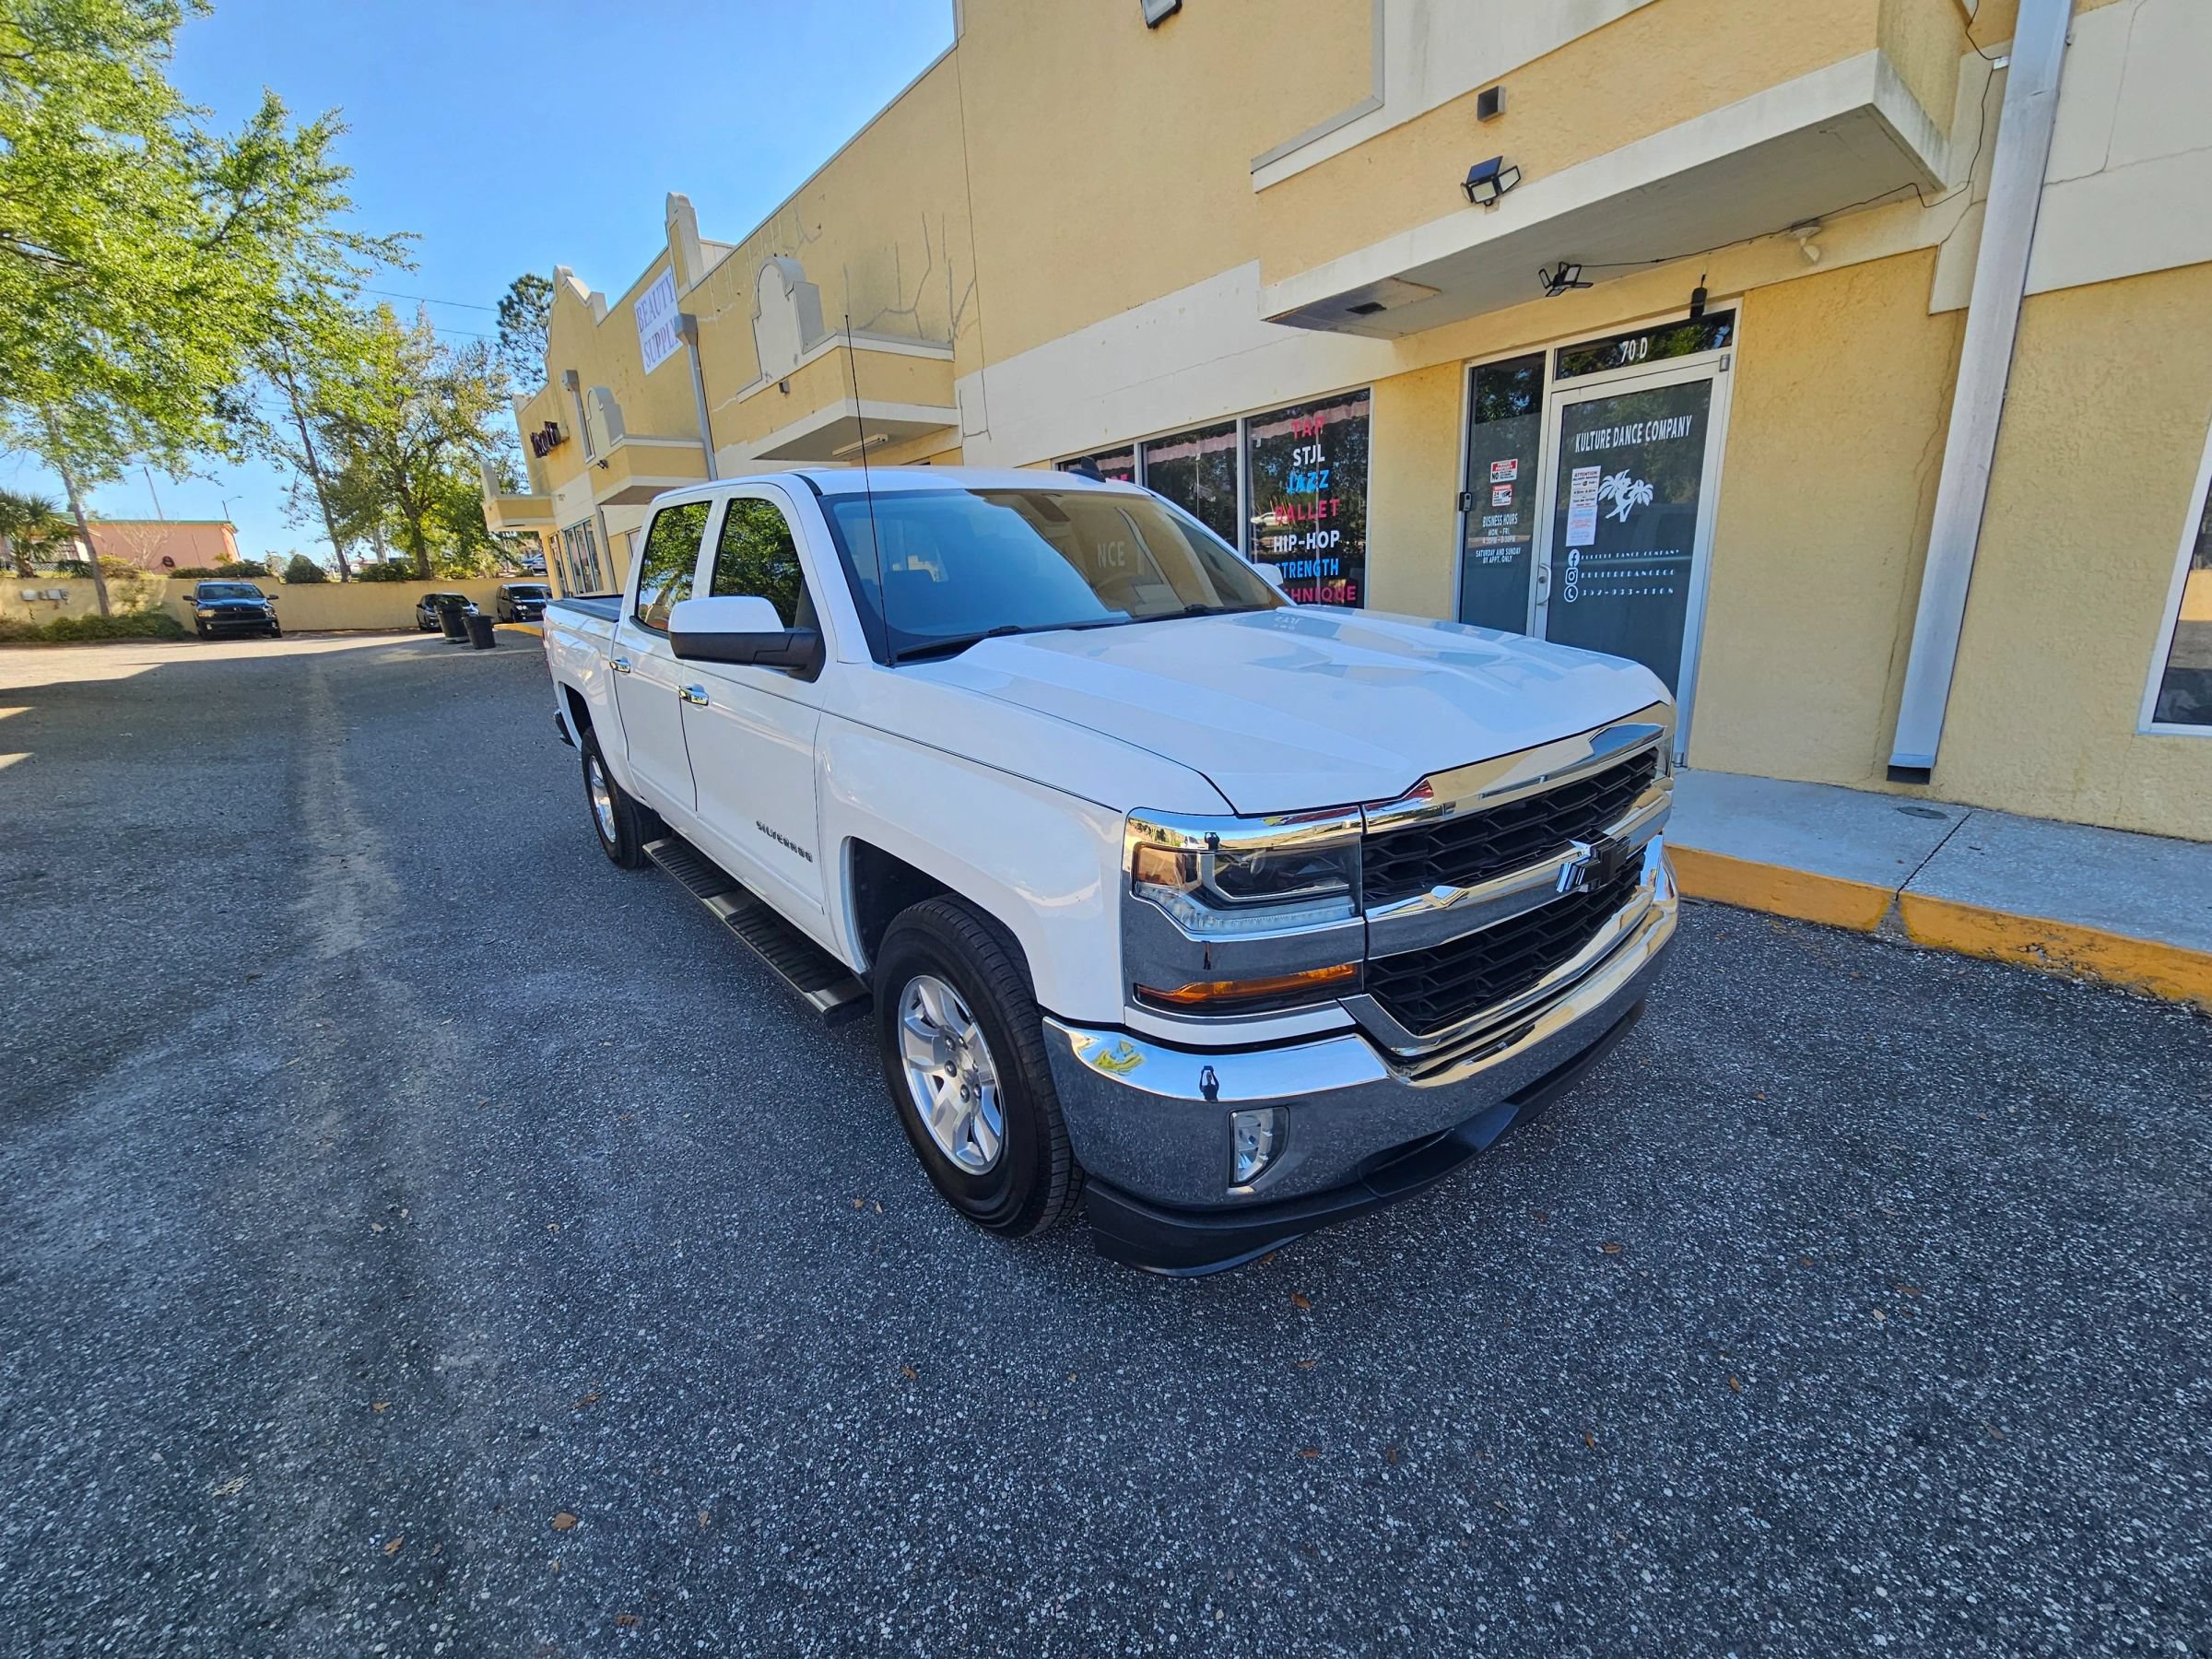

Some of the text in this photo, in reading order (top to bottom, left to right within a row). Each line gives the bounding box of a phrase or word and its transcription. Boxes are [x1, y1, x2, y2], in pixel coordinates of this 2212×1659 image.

[636, 274, 674, 333] BEAUTY
[1620, 336, 1648, 363] 70 D
[1291, 414, 1325, 441] TAP
[1575, 415, 1693, 453] KULTURE DANCE COMPANY
[1287, 469, 1330, 495] JAZZ
[1275, 498, 1342, 526] BALLET
[1482, 512, 1518, 528] BUSINESS HOURS
[1273, 530, 1340, 553] HIP-HOP
